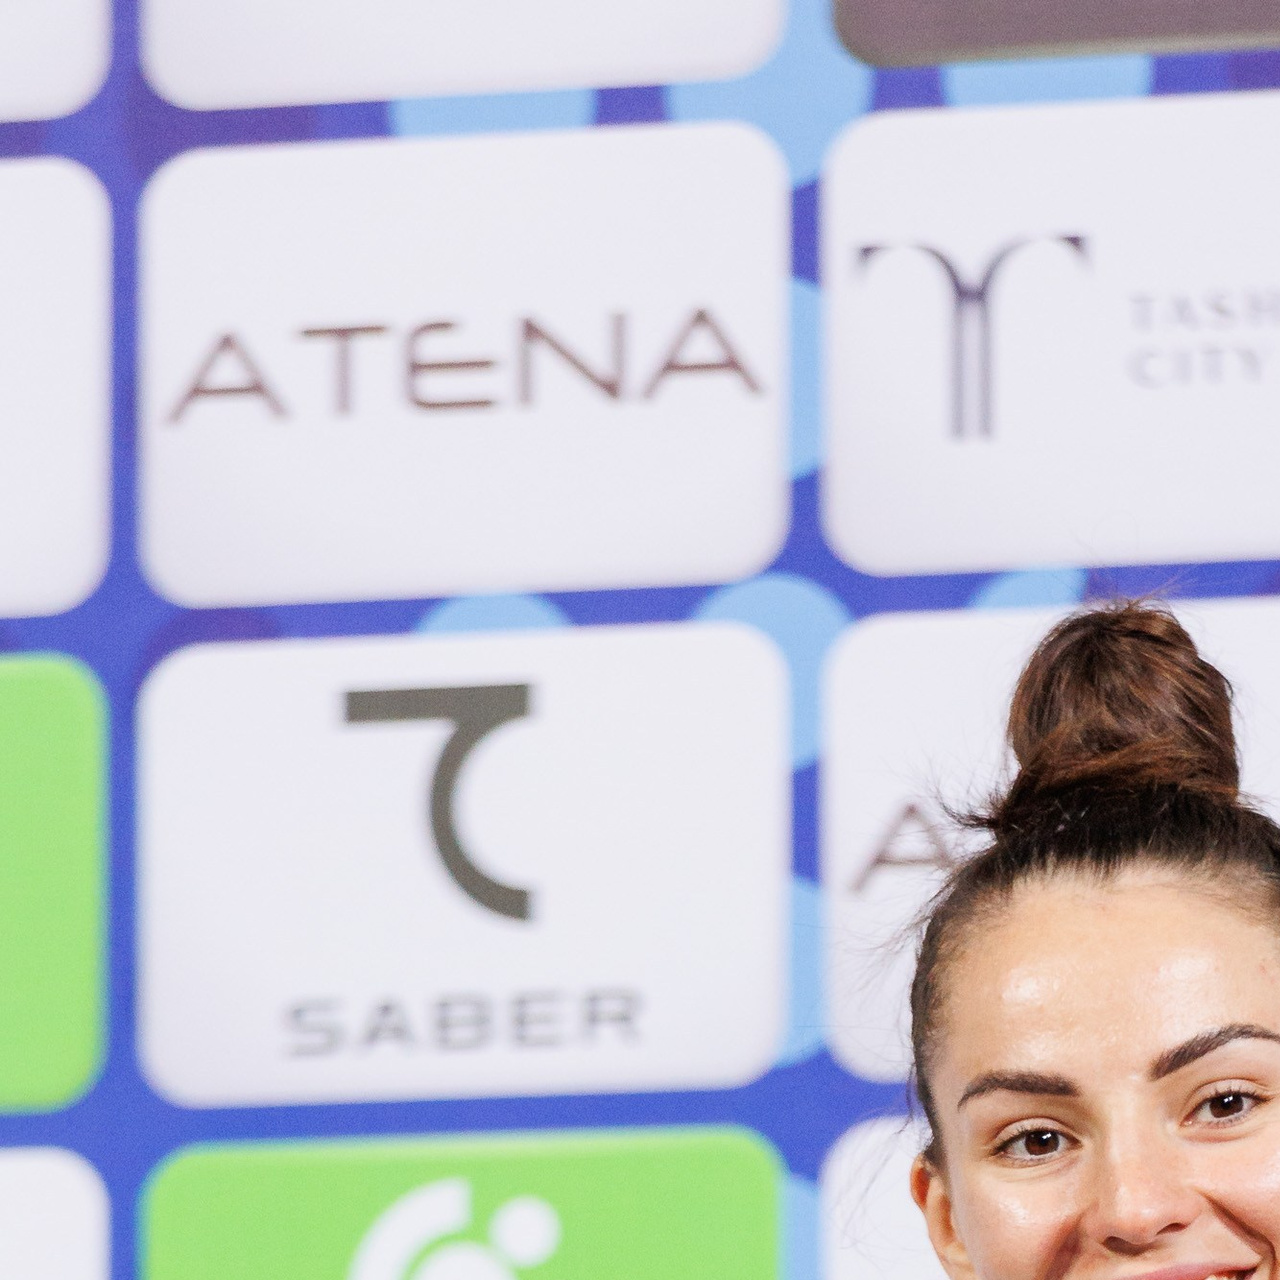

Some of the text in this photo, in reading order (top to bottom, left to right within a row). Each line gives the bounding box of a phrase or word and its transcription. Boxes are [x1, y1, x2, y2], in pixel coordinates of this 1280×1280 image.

[166, 308, 764, 424] ATENA
[1127, 345, 1270, 390] CITY
[284, 987, 645, 1058] SABER
